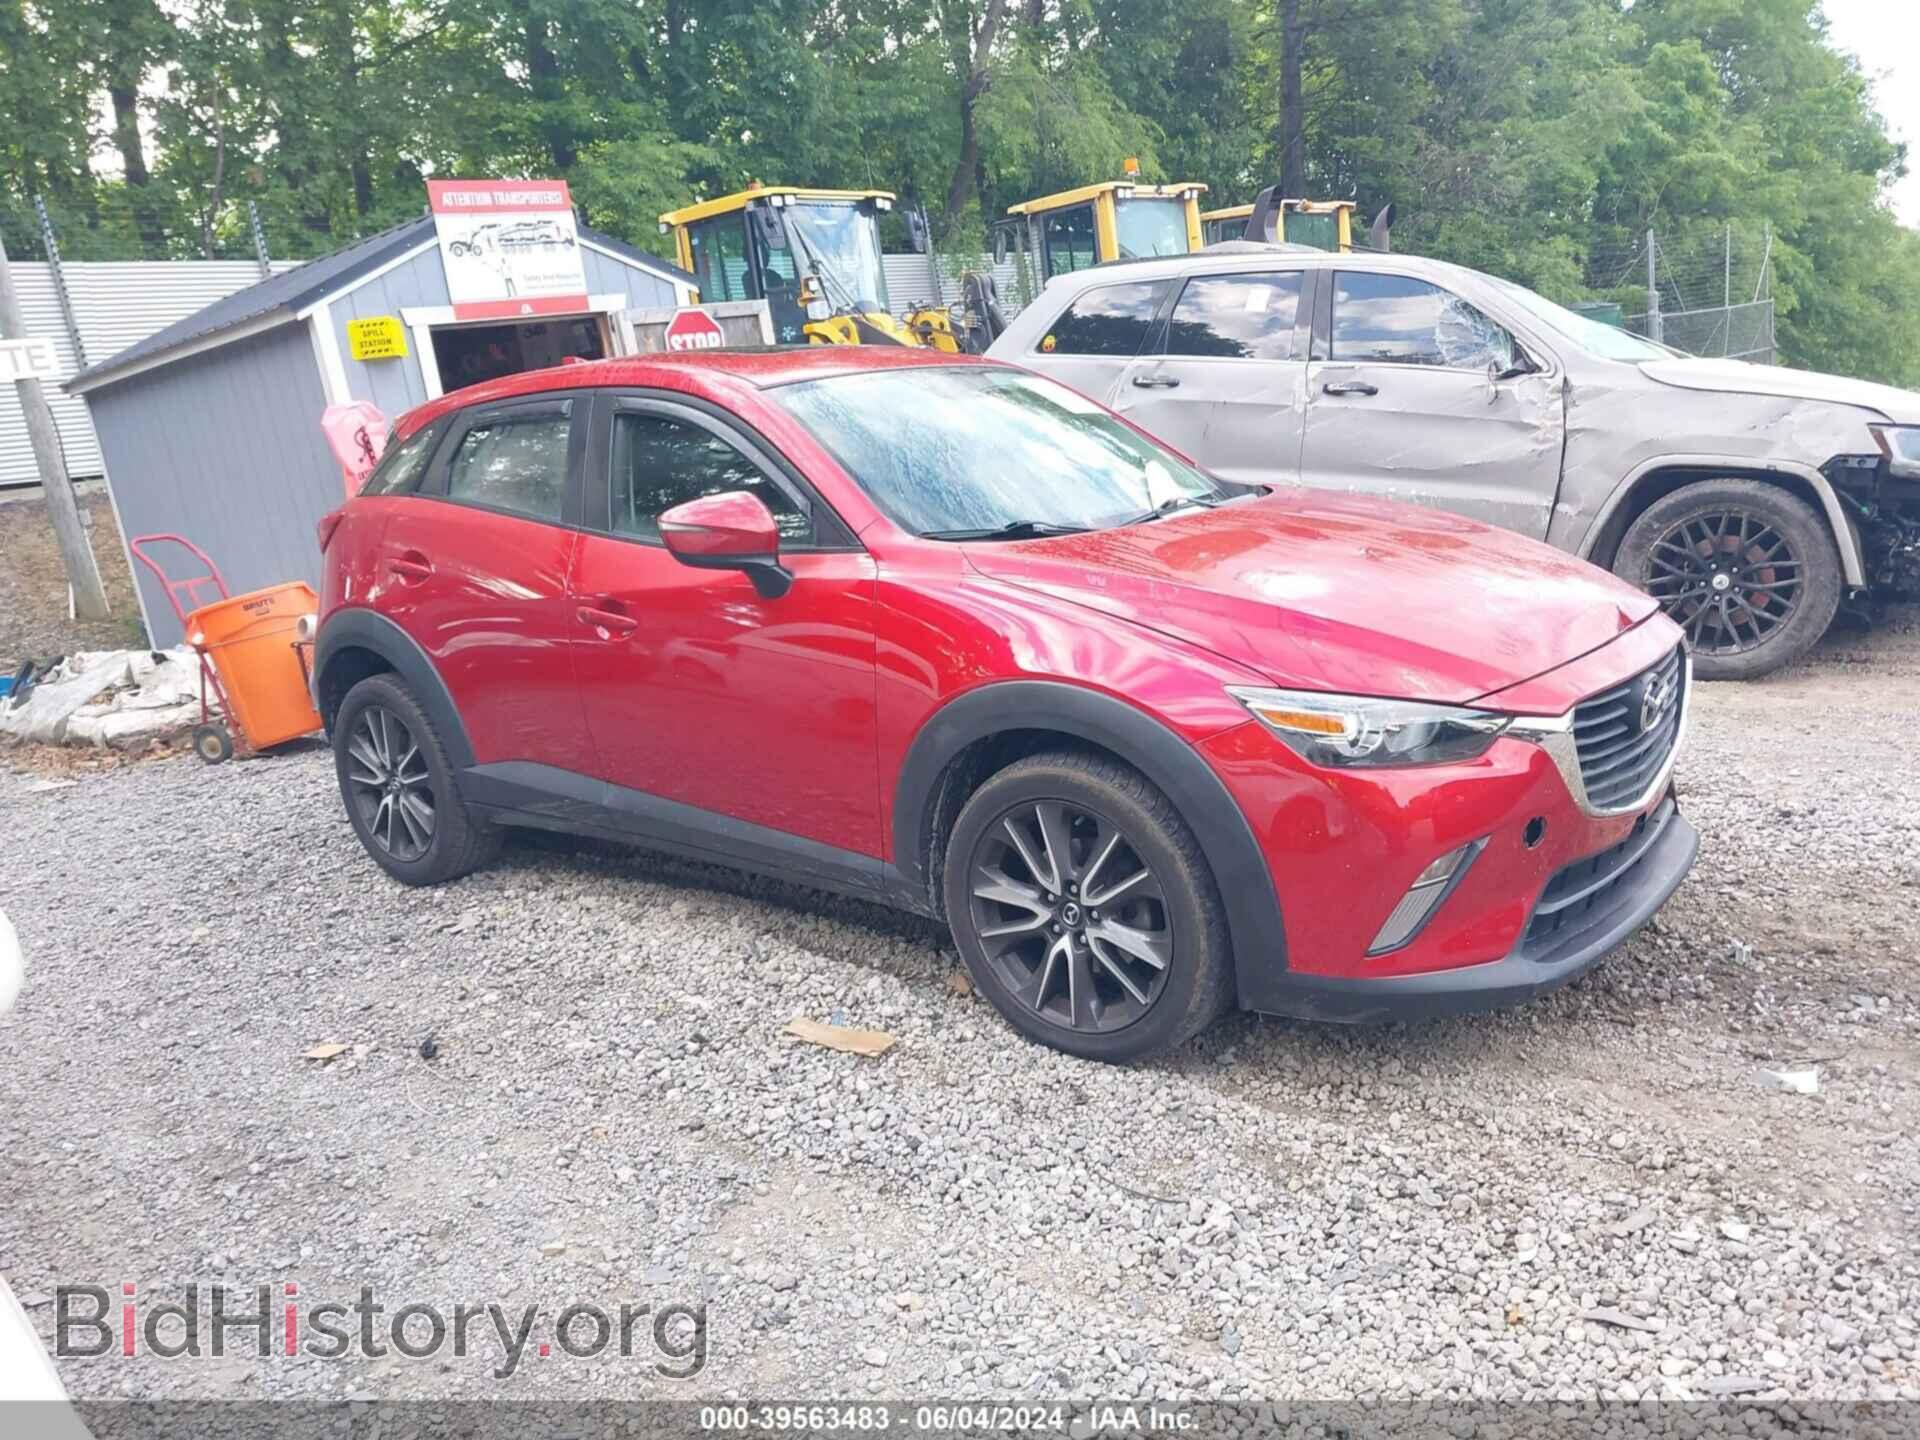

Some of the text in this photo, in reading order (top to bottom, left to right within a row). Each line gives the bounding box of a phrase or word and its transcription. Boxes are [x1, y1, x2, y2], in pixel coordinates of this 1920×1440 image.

[362, 328, 384, 338] SPILL
[360, 338, 392, 349] STATION
[670, 331, 720, 351] STOP
